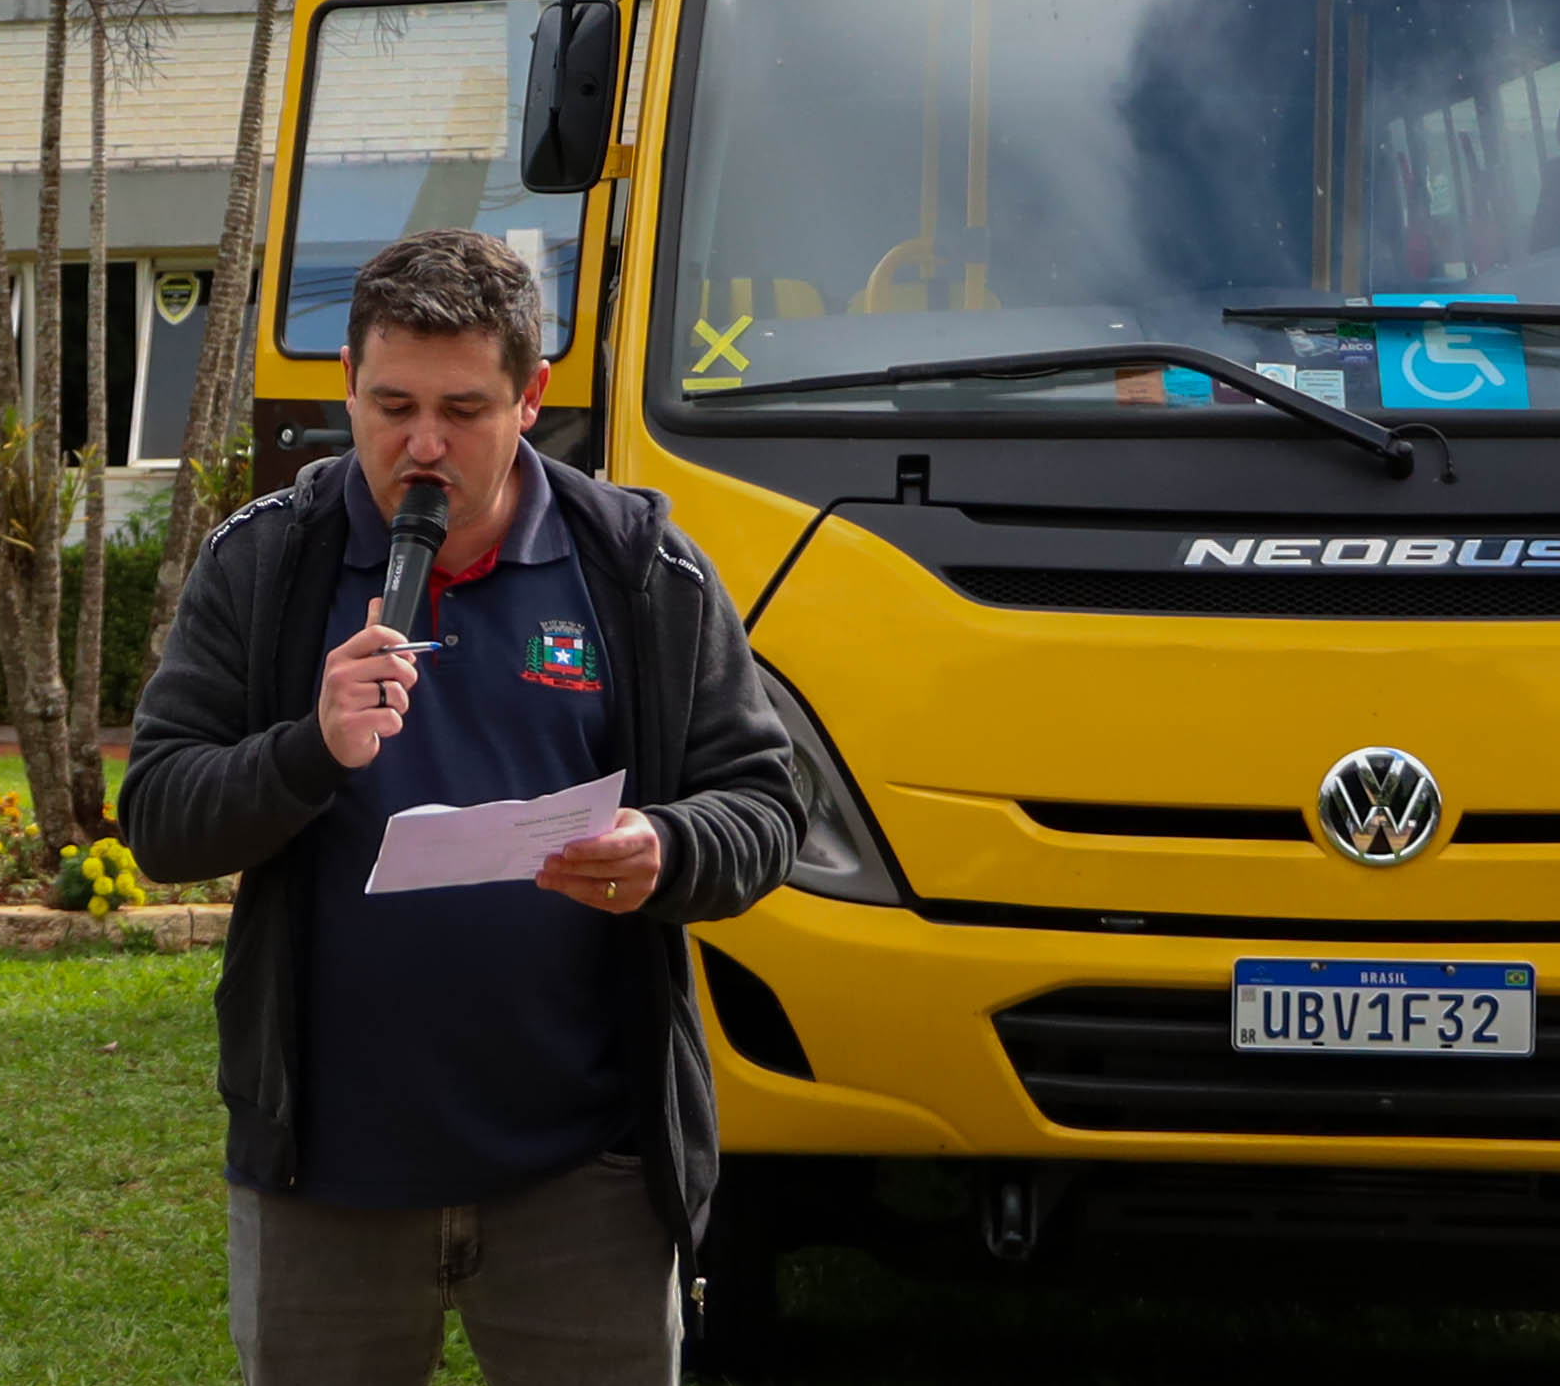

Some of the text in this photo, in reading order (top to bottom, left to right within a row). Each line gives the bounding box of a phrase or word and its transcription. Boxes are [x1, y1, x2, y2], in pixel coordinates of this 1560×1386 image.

[1360, 971, 1408, 986] BRASIL
[1263, 989, 1500, 1044] UBV1F32
[1240, 1028, 1257, 1045] BR
